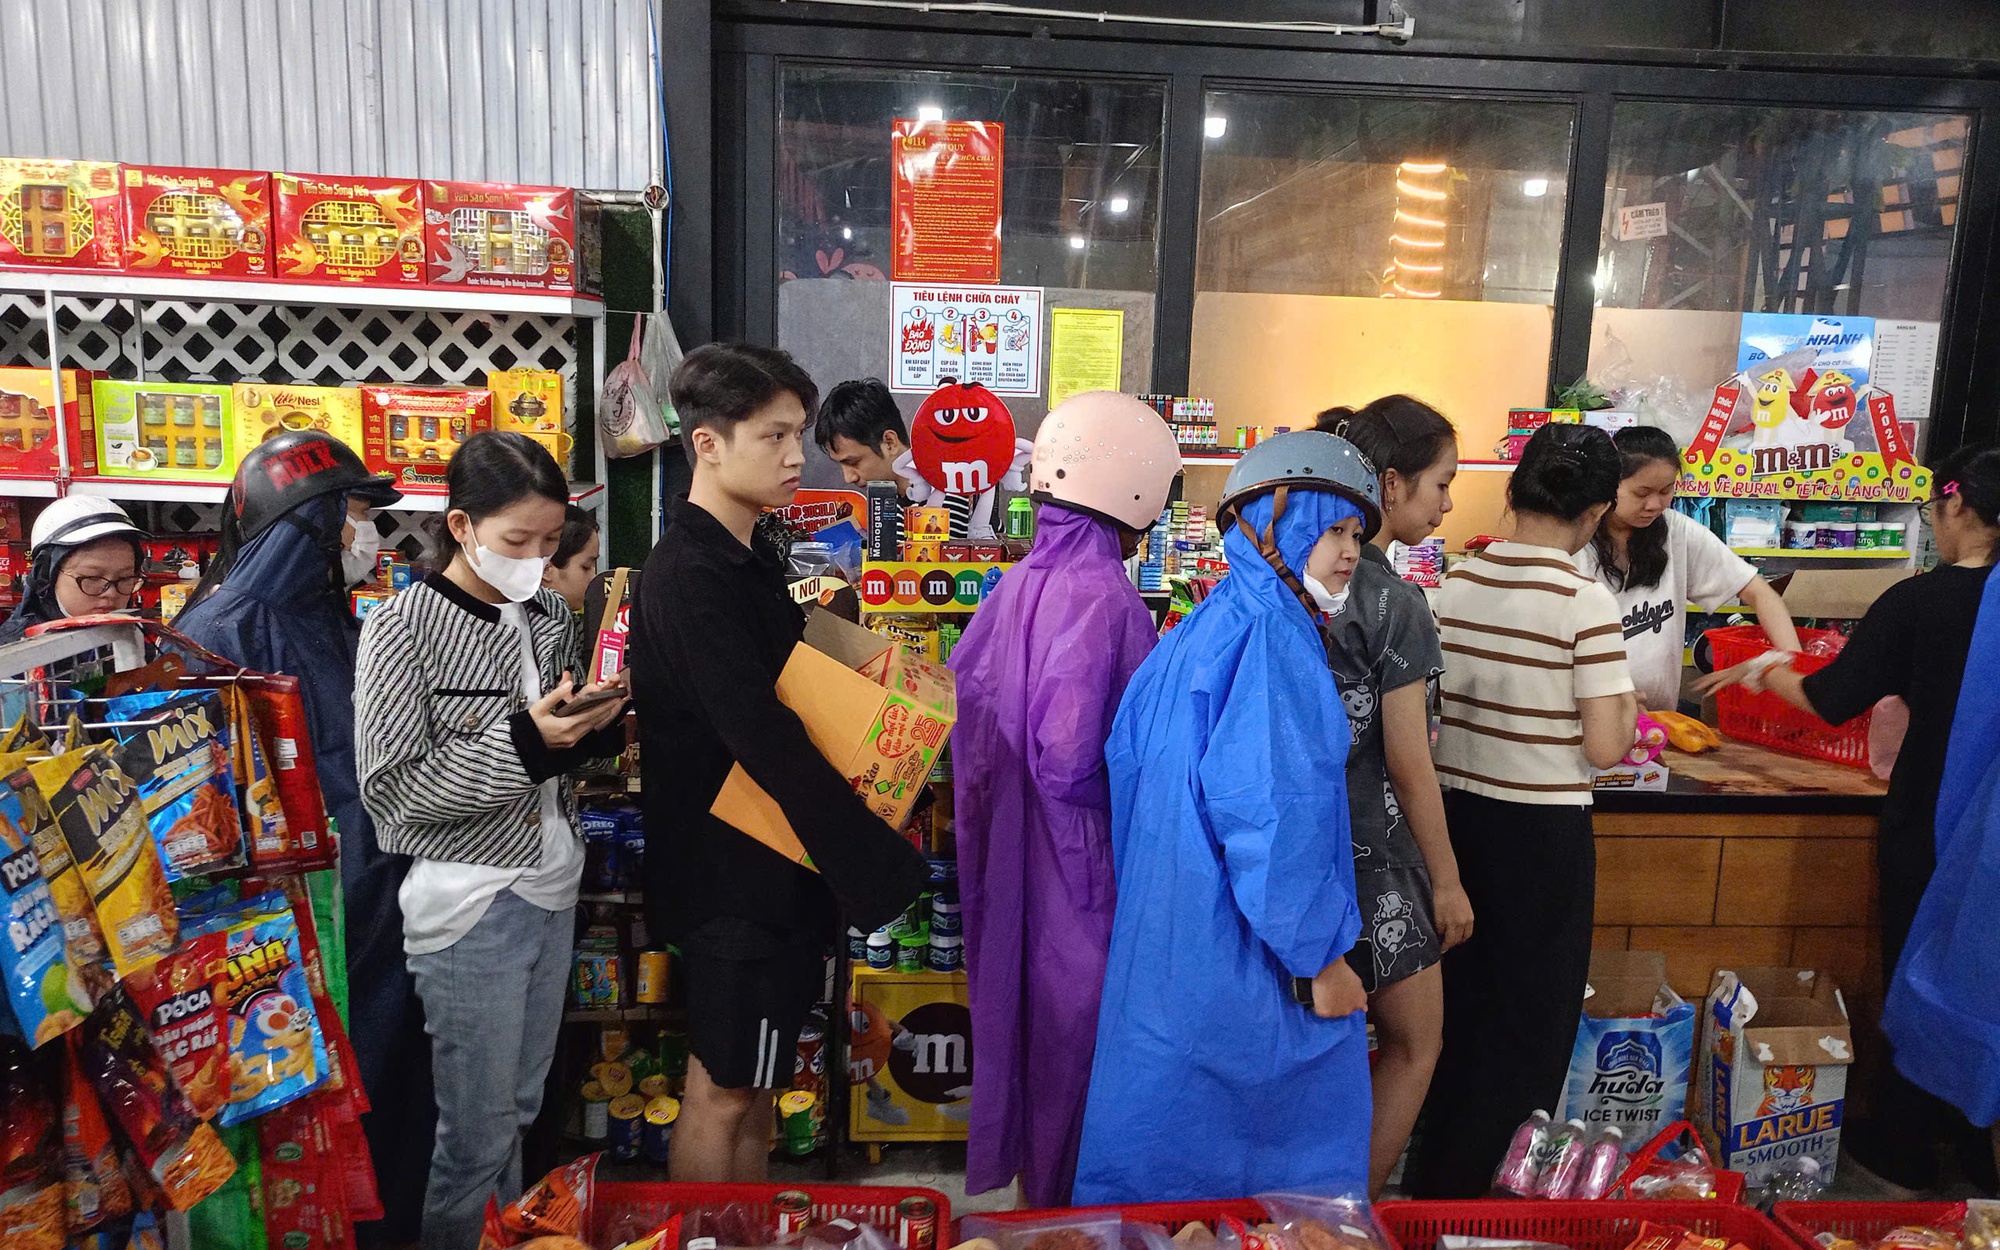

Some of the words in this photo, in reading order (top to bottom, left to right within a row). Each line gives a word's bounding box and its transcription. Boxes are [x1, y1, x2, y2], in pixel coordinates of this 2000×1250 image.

[913, 290, 934, 301] TIÊU
[938, 291, 963, 304] LỆNH
[965, 291, 992, 304] CHỮA
[994, 292, 1020, 304] CHÁY
[915, 309, 921, 317] 1
[947, 310, 954, 318] 2
[980, 311, 986, 319] 3
[1010, 312, 1017, 320] 4
[1806, 333, 1864, 346] NHANH
[1831, 406, 1849, 421] m
[942, 459, 991, 493] m
[1675, 481, 1709, 492] M&M
[1735, 482, 1780, 495] RURAL
[1886, 485, 1909, 498] VUI
[802, 502, 836, 518] SOCOLA
[873, 497, 881, 557] Monogatari
[800, 577, 820, 599] NƠI
[867, 580, 885, 595] m
[898, 580, 917, 595] m
[929, 580, 947, 595] m
[959, 580, 978, 595] m
[1622, 599, 1674, 633] oklyn
[581, 821, 615, 830] OREO
[156, 989, 212, 1025] POCA
[913, 1034, 967, 1073] m
[1588, 1071, 1665, 1095] huda
[1584, 1109, 1611, 1121] ICE
[1616, 1109, 1661, 1121] TWIST
[1740, 1104, 1835, 1149] LARUE
[1747, 1136, 1824, 1166] SMOOTH
